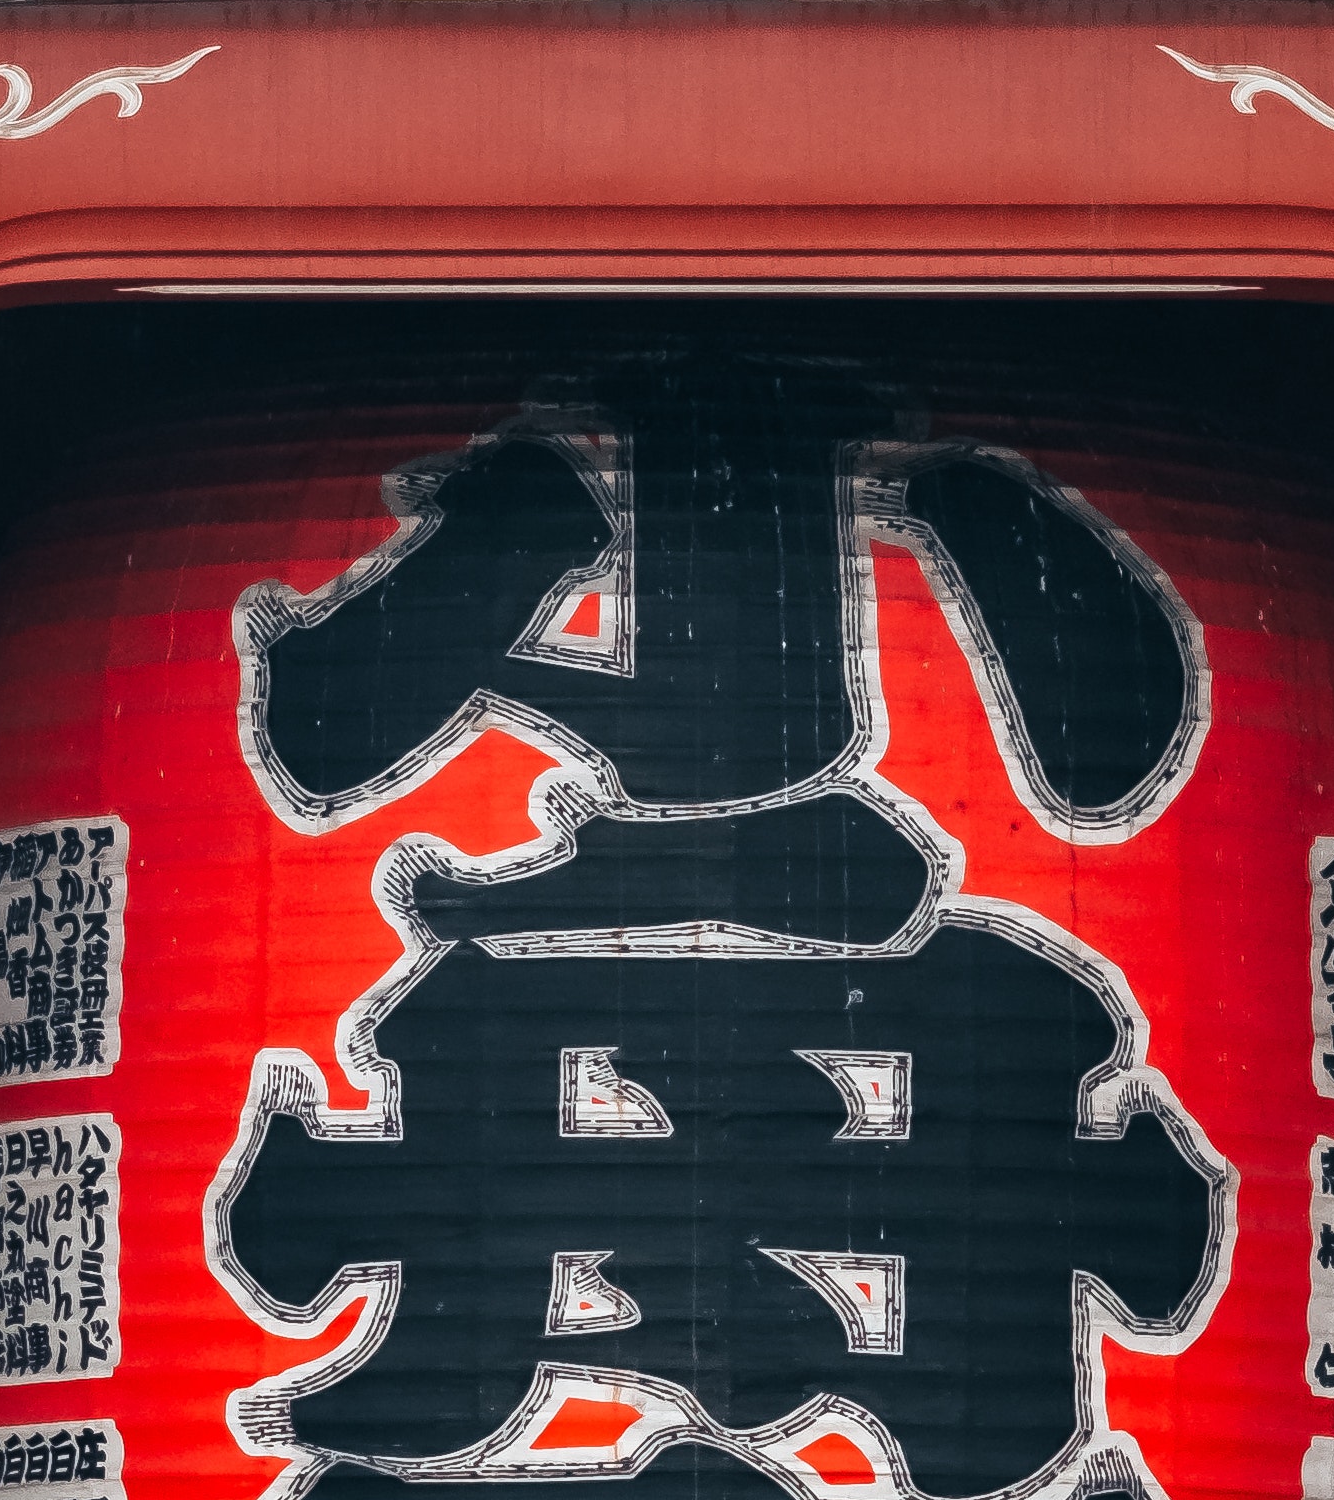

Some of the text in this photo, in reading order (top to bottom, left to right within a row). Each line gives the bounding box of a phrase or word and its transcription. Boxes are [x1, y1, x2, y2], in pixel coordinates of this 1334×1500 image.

[25, 830, 58, 1072] アトム商事
[78, 826, 115, 1065] アーパス技研工業
[24, 1127, 52, 1375] 早川商事
[77, 1124, 112, 1370] ハタヤリミテッド
